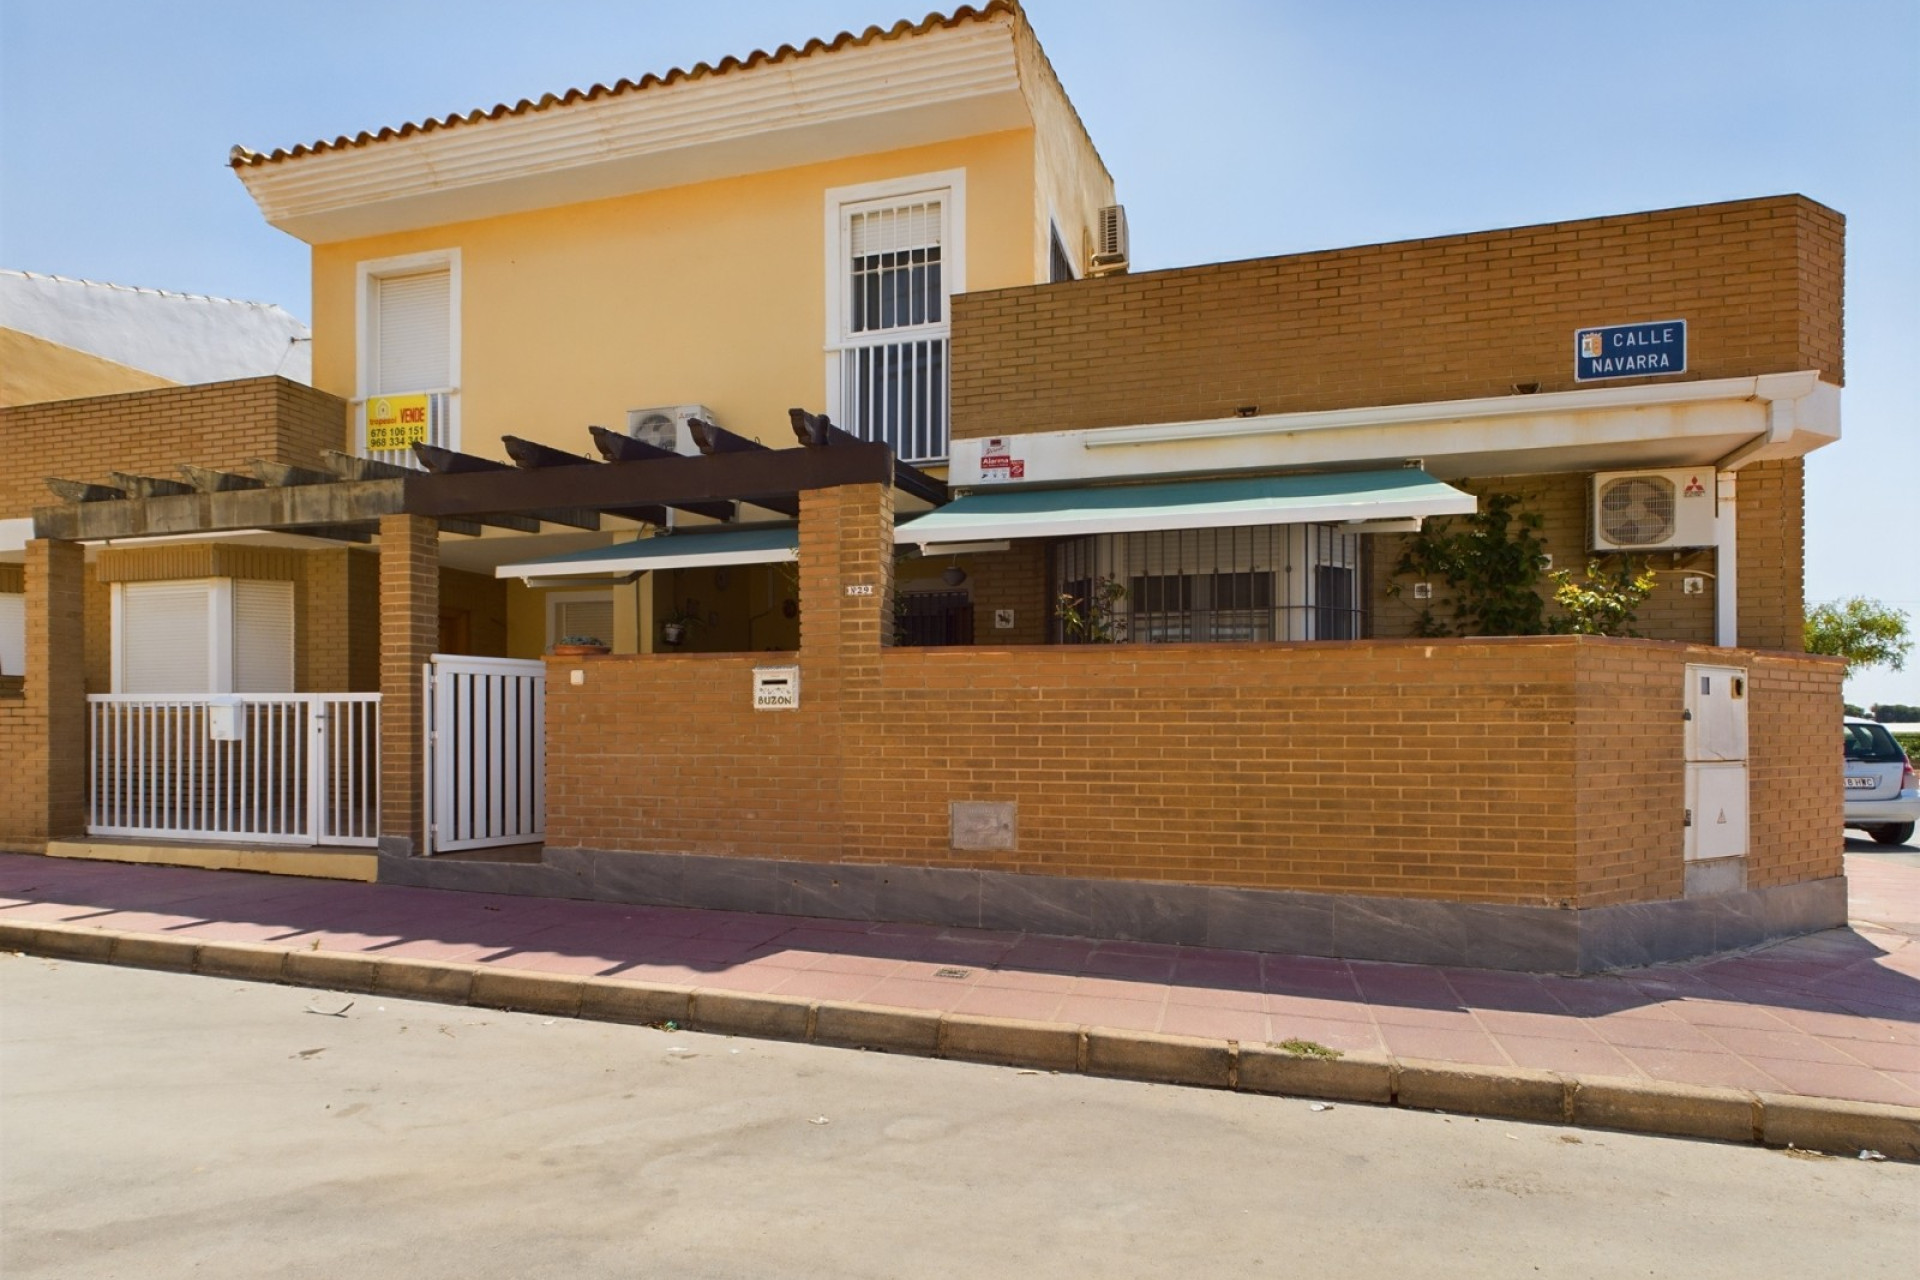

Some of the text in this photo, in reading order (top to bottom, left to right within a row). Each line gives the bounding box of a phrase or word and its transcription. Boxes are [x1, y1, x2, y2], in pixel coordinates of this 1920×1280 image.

[1613, 328, 1674, 347] CALLE
[1592, 353, 1670, 374] NAVARRA
[400, 407, 425, 423] VENDE
[370, 426, 424, 437] 676 106 151
[370, 438, 386, 447] 968
[389, 437, 405, 446] 334
[982, 457, 1009, 465] Alarma
[757, 695, 792, 705] BUZON
